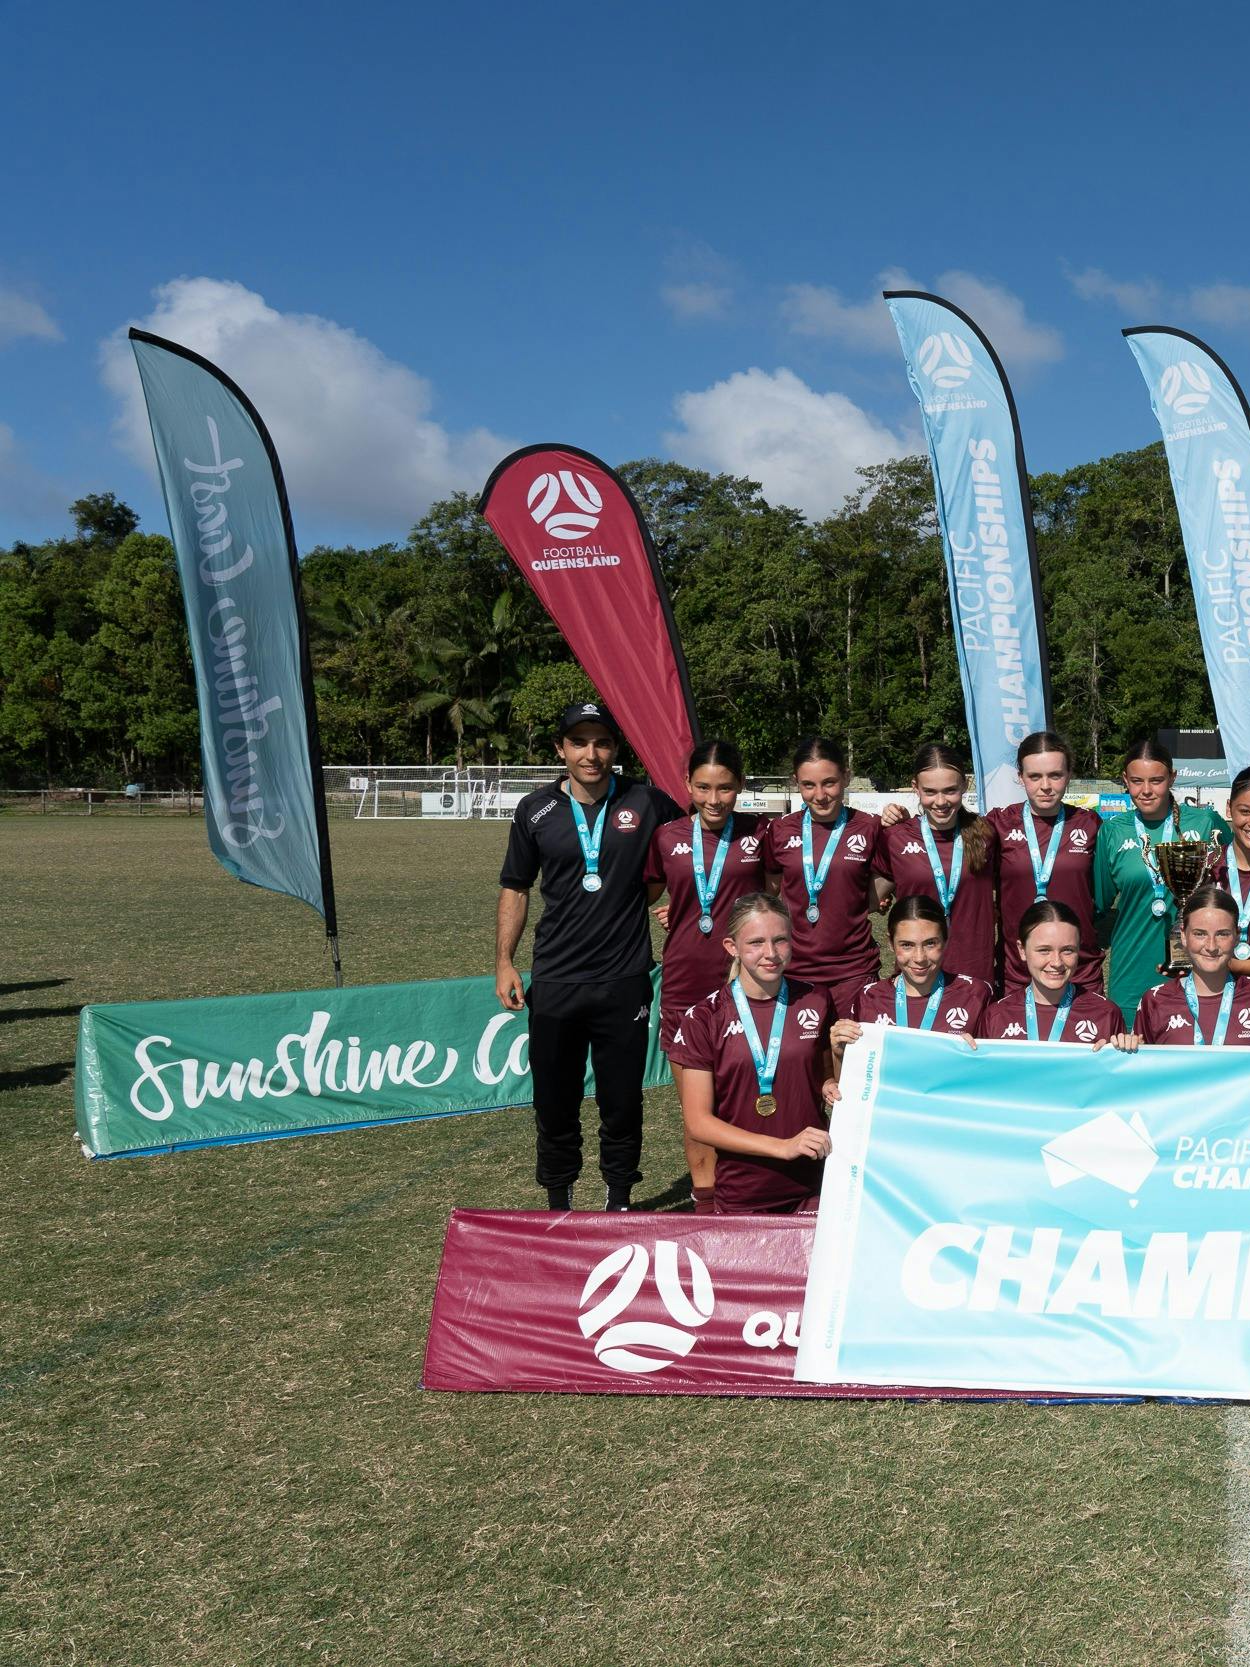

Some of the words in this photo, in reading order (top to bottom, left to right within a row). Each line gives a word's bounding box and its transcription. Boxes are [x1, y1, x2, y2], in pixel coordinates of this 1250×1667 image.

[531, 555, 621, 571] QUEENSLAND
[543, 545, 605, 559] FOOTBALL
[950, 530, 990, 651] PACIFIC
[968, 438, 1029, 748] CHAMPIONSHIPS
[1202, 547, 1249, 664] PACIFIC
[130, 1011, 459, 1122] Sunshine
[862, 1050, 877, 1102] CHAMPIONS
[844, 1164, 859, 1224] MPIONS
[825, 1289, 841, 1350] CHAMPION
